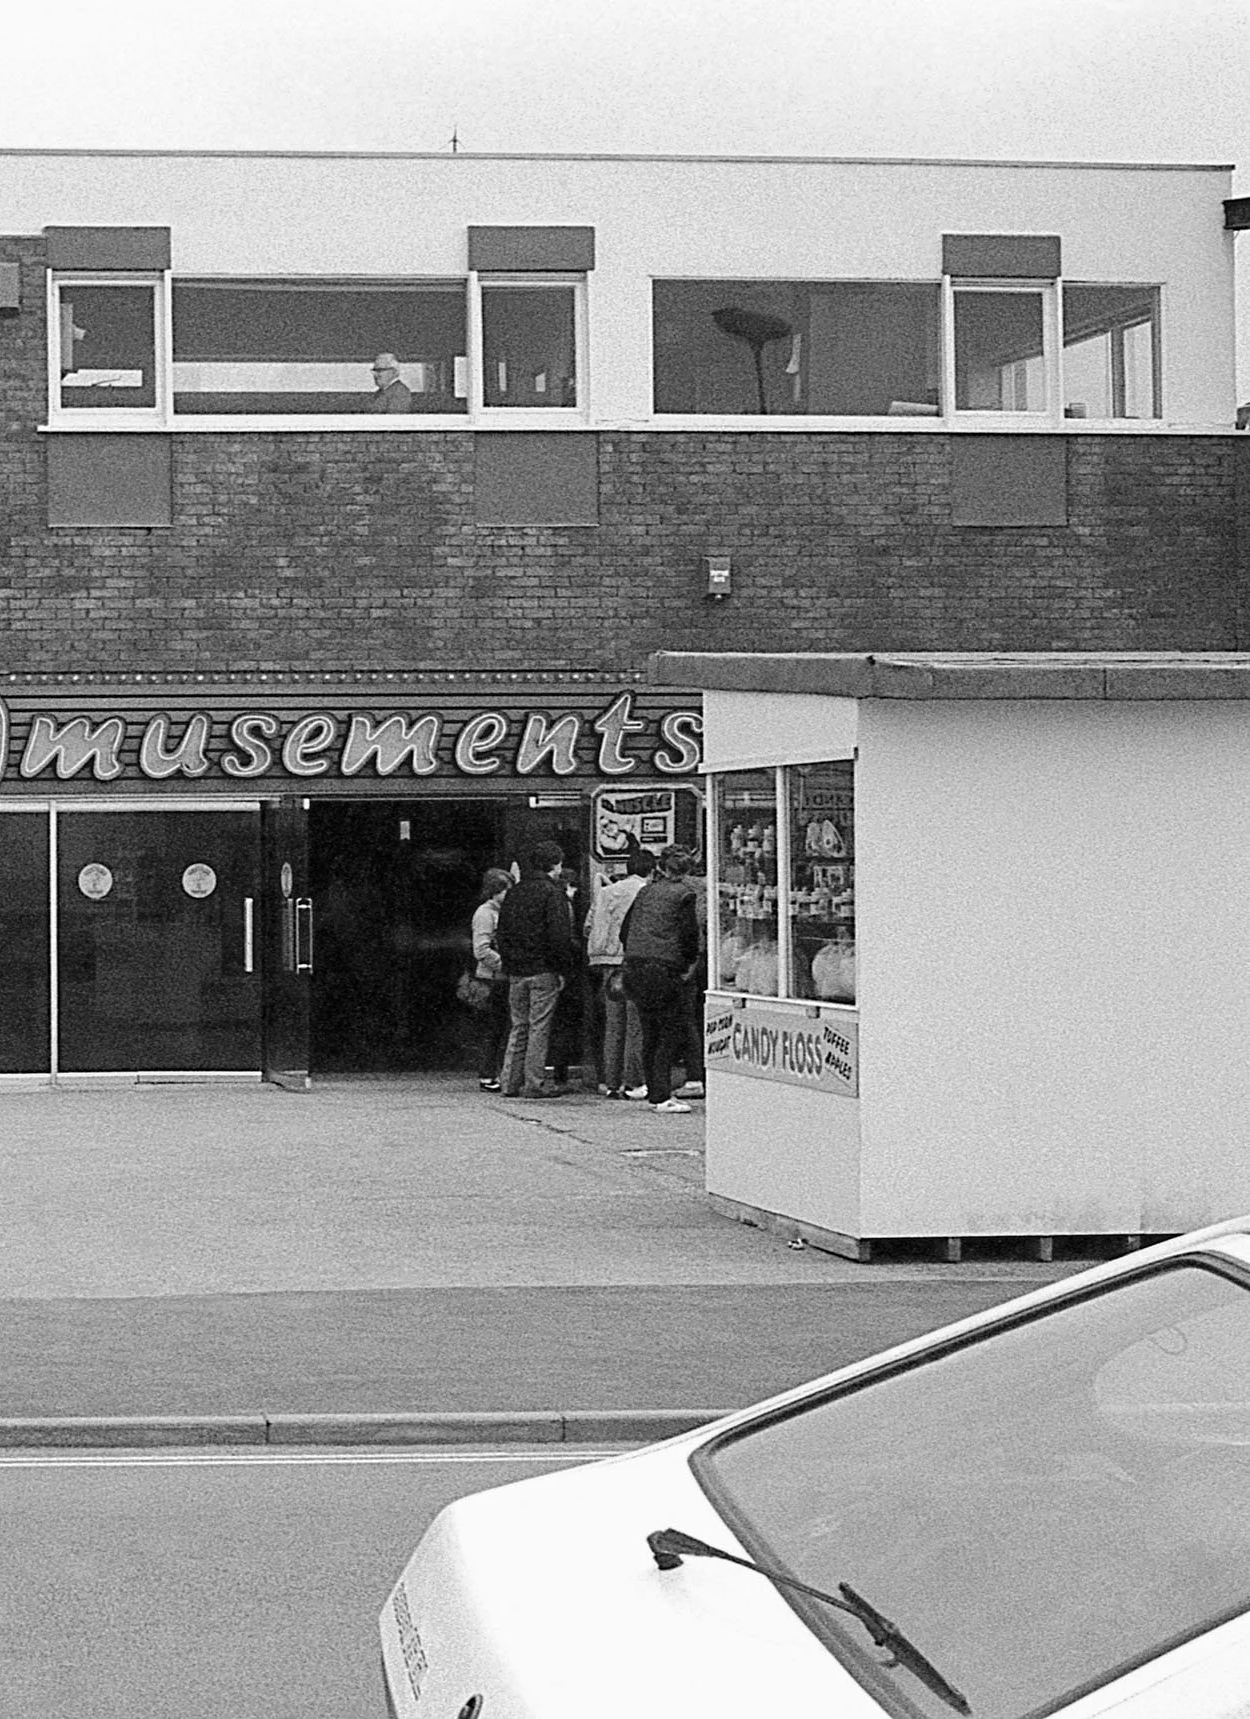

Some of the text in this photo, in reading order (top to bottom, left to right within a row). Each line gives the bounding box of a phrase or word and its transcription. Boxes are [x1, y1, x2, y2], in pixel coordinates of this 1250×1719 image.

[732, 1022, 823, 1076] CANDY FLOSS
[823, 1026, 850, 1056] TOFFEE
